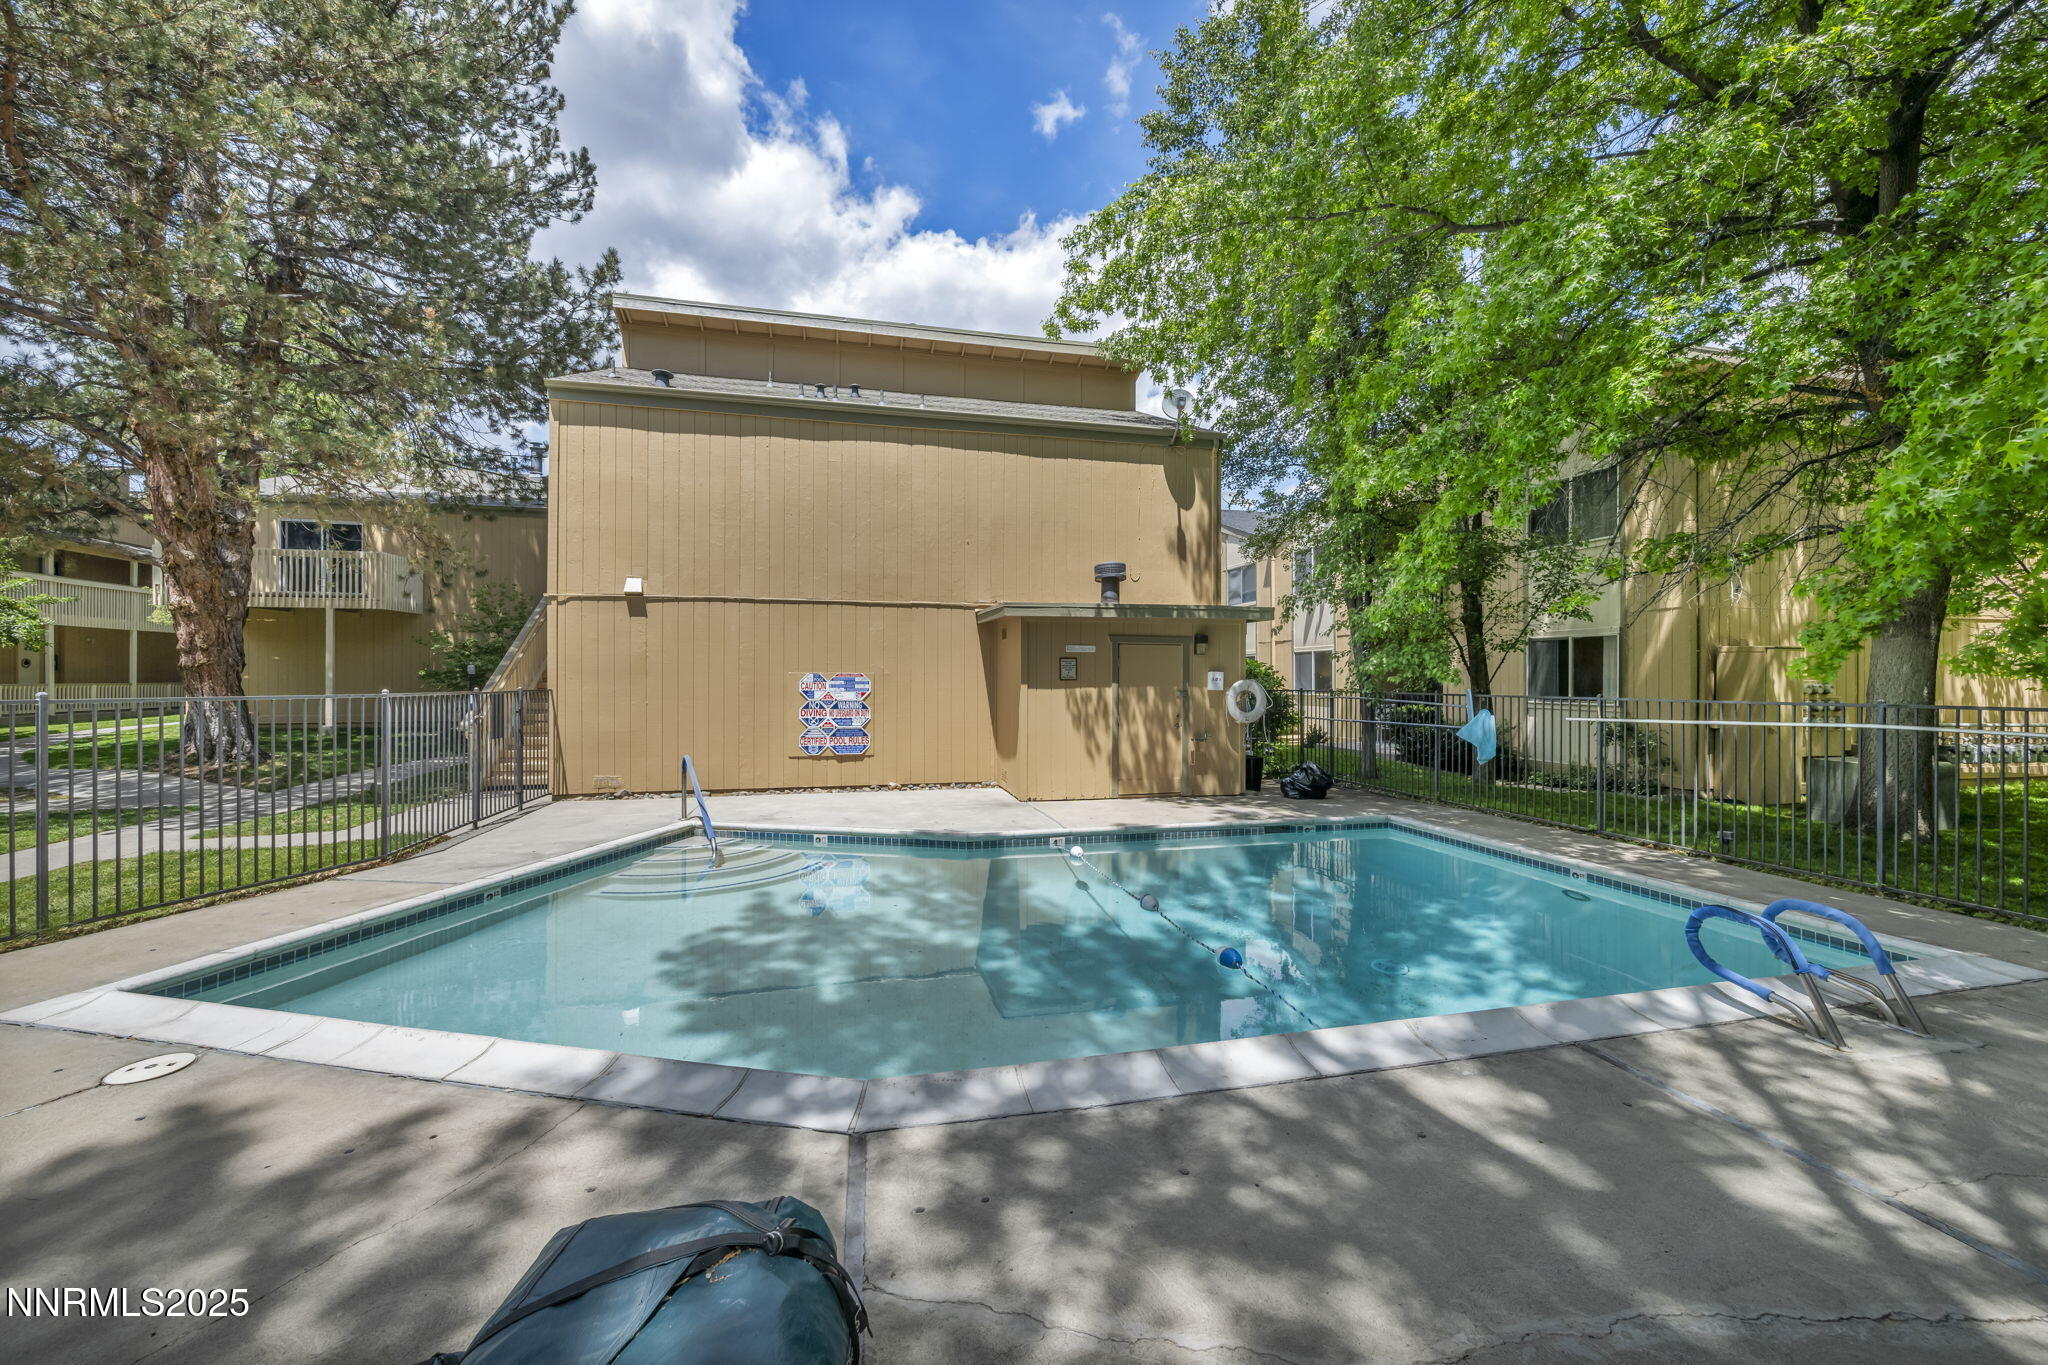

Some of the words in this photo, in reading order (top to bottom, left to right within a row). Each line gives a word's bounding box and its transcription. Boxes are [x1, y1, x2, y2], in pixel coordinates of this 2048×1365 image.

[800, 682, 827, 690] CAUTION
[808, 701, 820, 709] NO
[838, 701, 862, 709] WARNING
